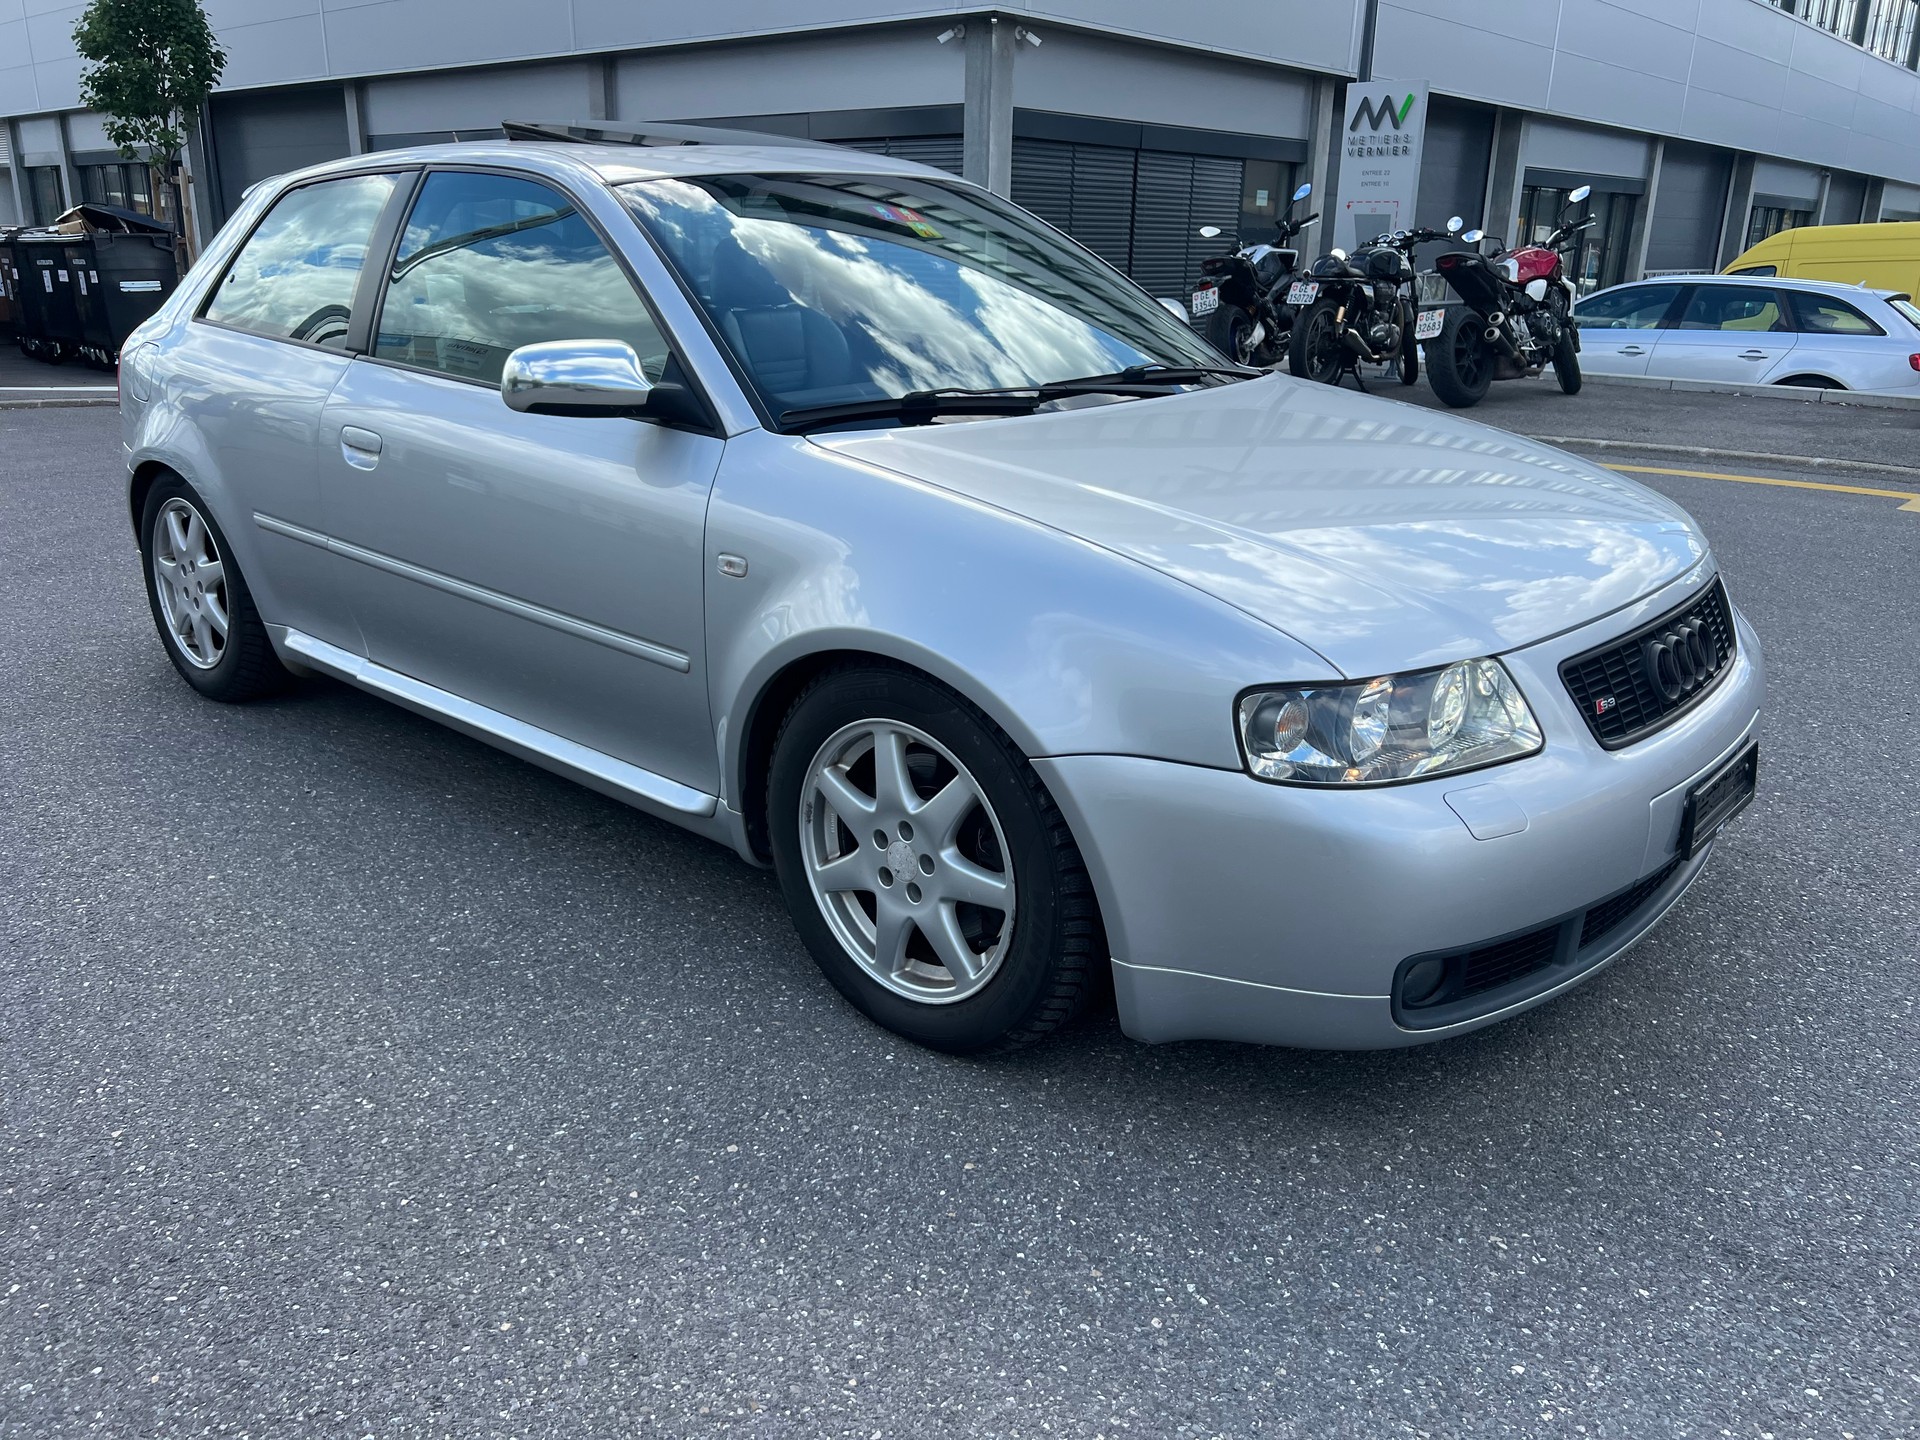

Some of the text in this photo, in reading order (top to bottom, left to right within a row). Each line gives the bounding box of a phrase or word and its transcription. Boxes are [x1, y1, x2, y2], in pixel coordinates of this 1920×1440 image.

[1348, 134, 1410, 146] METIERS
[1347, 146, 1409, 157] VERNIER
[1200, 291, 1210, 300] GE
[1194, 298, 1217, 311] 33540
[1425, 311, 1436, 321] GE
[1417, 321, 1441, 333] 32683
[1600, 697, 1616, 711] S3
